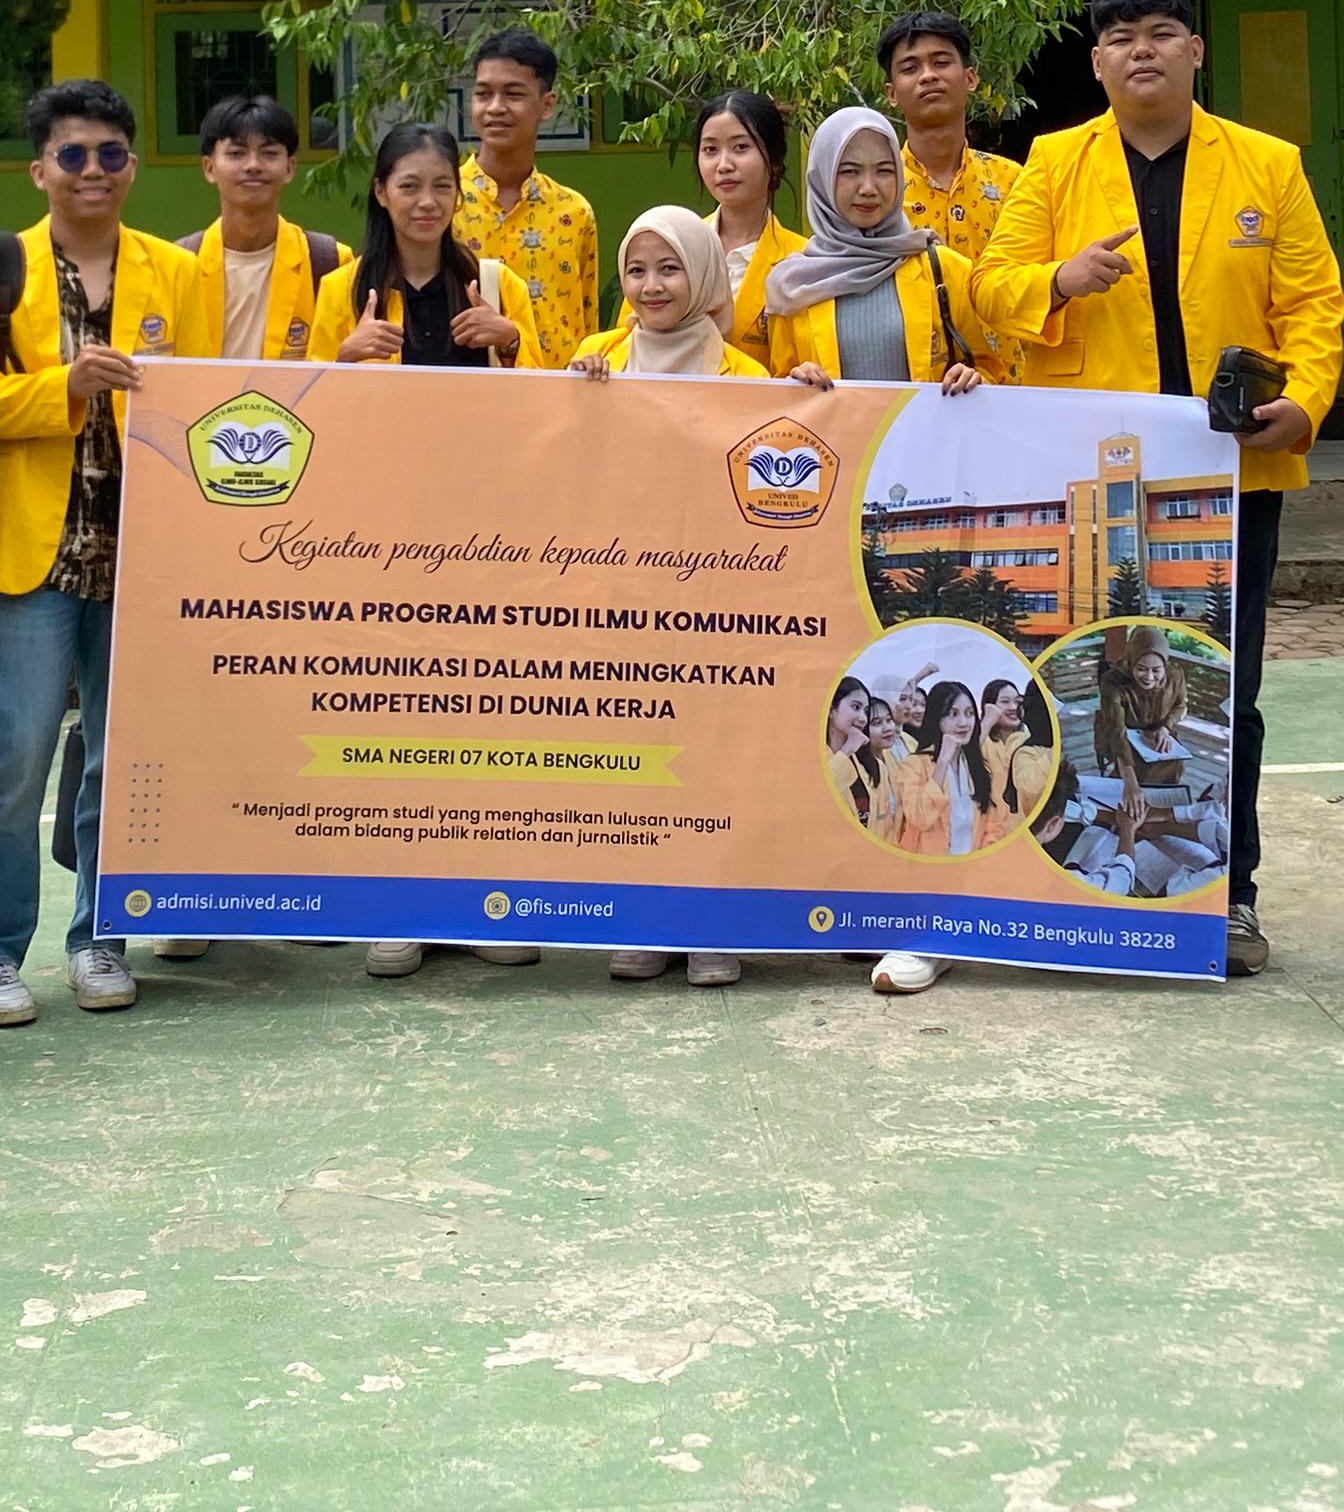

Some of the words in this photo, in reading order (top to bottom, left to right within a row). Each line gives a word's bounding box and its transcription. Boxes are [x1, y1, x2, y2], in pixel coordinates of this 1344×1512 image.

[200, 404, 261, 430] UNIVERSITAS
[237, 518, 384, 572] Kegiatan
[383, 532, 533, 574] pengabdian
[539, 535, 629, 576] kepada
[635, 542, 789, 582] masyarakat
[180, 598, 355, 622] MAHASISWA
[360, 601, 497, 625] PROGRAM
[502, 605, 580, 628] STUDI
[585, 607, 648, 630] ILMU
[654, 610, 827, 637] KOMUNIKASI
[212, 654, 297, 675] PERAN
[303, 655, 468, 678] KOMUNIKASI
[473, 658, 563, 680] DALAM
[569, 660, 775, 687] MENINGKATKAN
[311, 692, 473, 714] KOMPETENSI
[478, 694, 504, 715] DI
[510, 695, 590, 717] DUNIA
[596, 697, 676, 720] KERJA
[342, 747, 384, 764] SMA
[389, 748, 455, 765] NEGERI
[459, 749, 483, 766] 07
[487, 750, 538, 767] KOTA
[543, 752, 641, 771] BENGKULU
[243, 802, 311, 821] Menjadi
[314, 806, 389, 823] program
[392, 805, 435, 820] studi
[437, 808, 481, 825] yang
[484, 807, 604, 830] menghasilkan
[608, 810, 669, 827] lulusan
[672, 815, 731, 834] unggul
[294, 822, 350, 837] dalam
[354, 822, 414, 843] bidang
[417, 825, 470, 843] publik
[473, 824, 537, 842] relation
[540, 828, 574, 843] dan
[576, 828, 659, 848] jurnalistik
[156, 892, 322, 911] admisi.unived.ac.id
[514, 897, 614, 917] @fis.unived
[838, 911, 856, 928] Jl.
[862, 914, 927, 930] meranti
[932, 915, 973, 937] Raya
[978, 919, 1029, 939] No.32
[1034, 924, 1114, 946] Bengkulu
[1119, 930, 1176, 950] 38228
